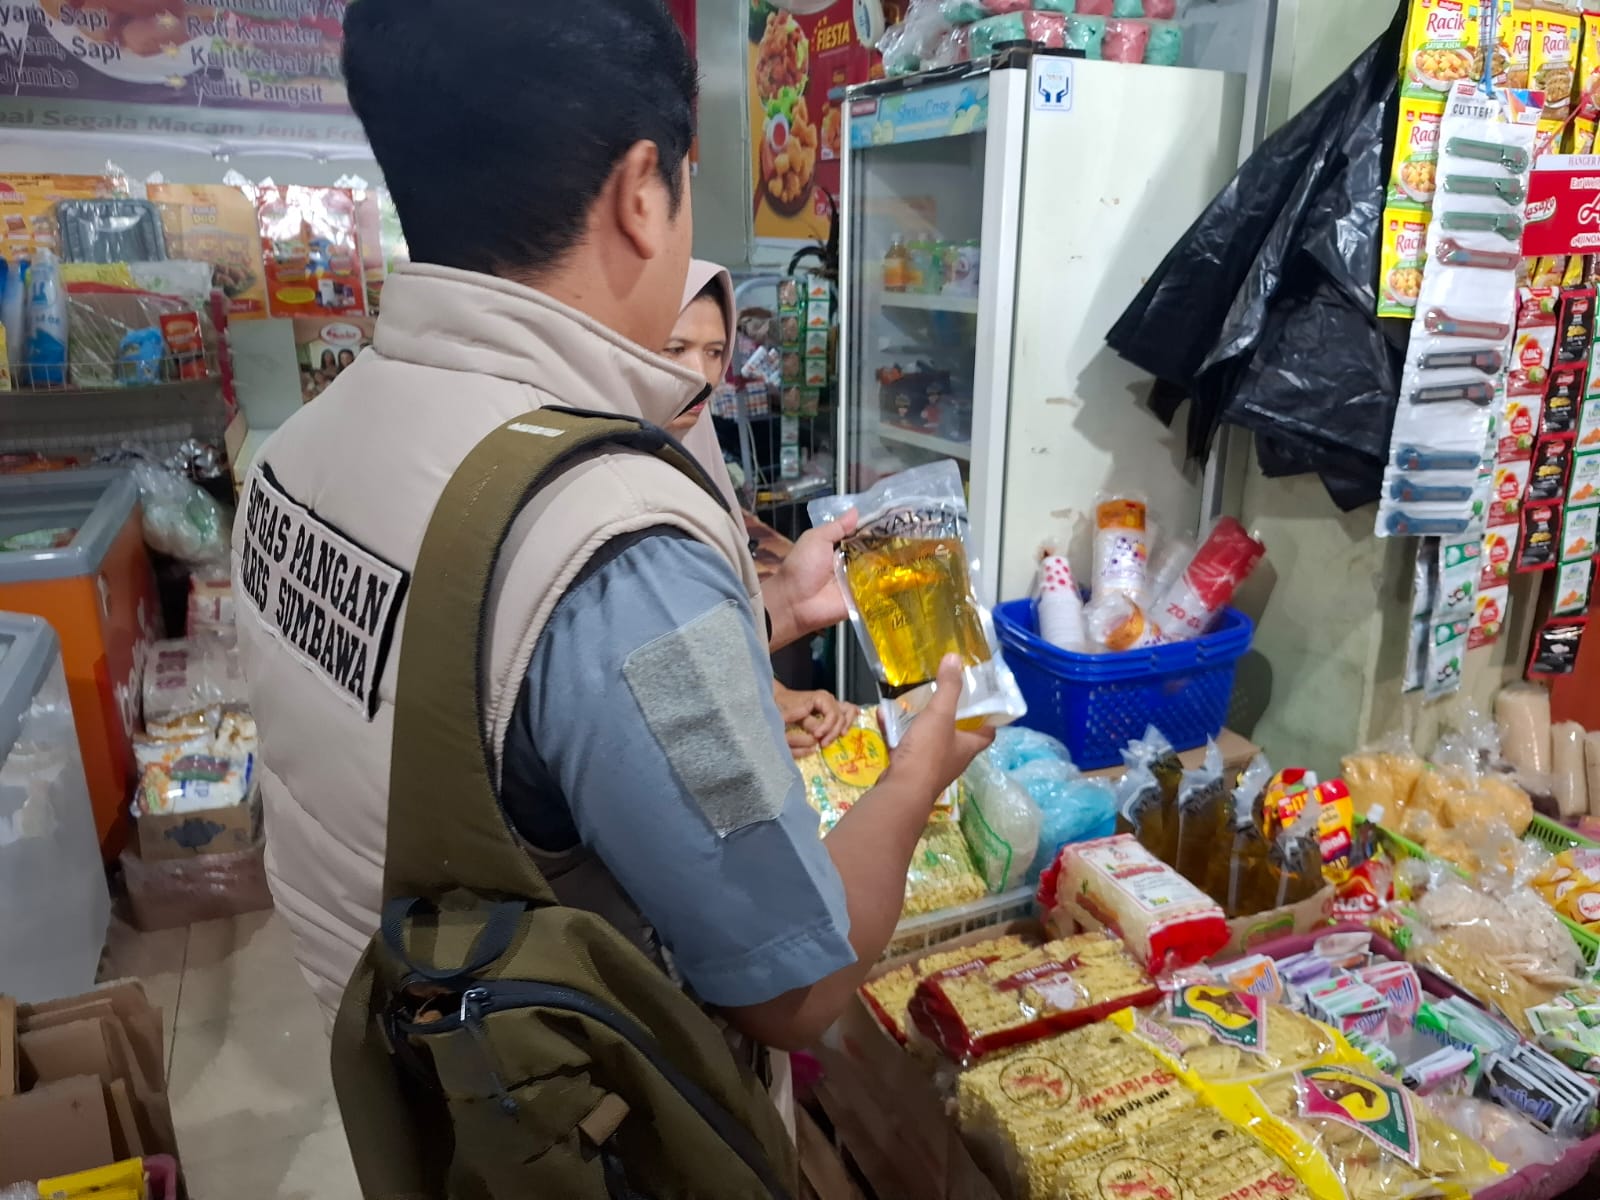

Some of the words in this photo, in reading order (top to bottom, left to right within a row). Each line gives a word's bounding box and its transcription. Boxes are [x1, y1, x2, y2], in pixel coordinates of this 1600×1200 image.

[60, 3, 109, 30] Sapi
[187, 16, 228, 38] Roti
[1426, 12, 1466, 33] Racik
[817, 21, 849, 50] FIESTA
[72, 36, 121, 63] Sapi
[190, 46, 238, 70] Kulit
[194, 76, 241, 97] Kulit
[248, 79, 323, 107] Pangsit
[148, 114, 244, 136] Macam
[289, 523, 390, 637] PANGAN
[276, 576, 367, 702] SUMBAWA
